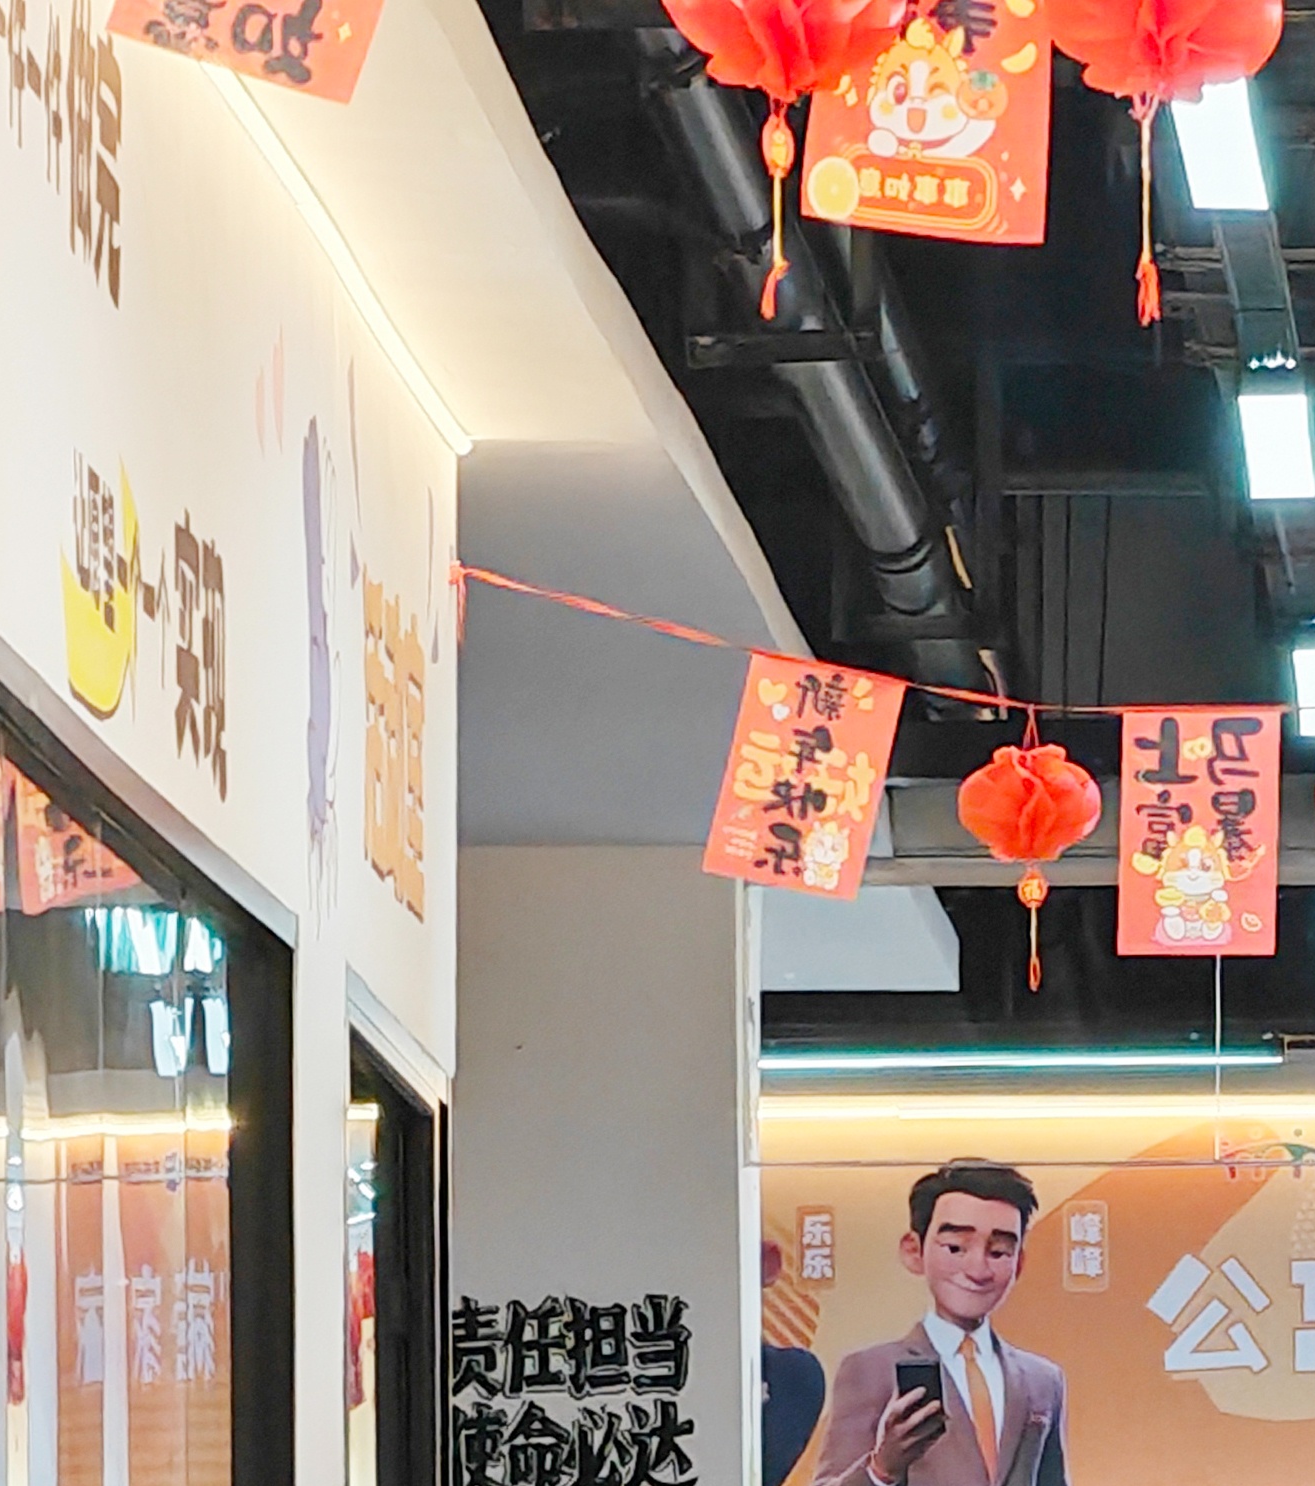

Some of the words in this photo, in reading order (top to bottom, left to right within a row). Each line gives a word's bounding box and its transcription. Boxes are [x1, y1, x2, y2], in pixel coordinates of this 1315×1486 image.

[801, 1213, 834, 1279] 乐乐
[451, 1294, 693, 1400] 责任担当
